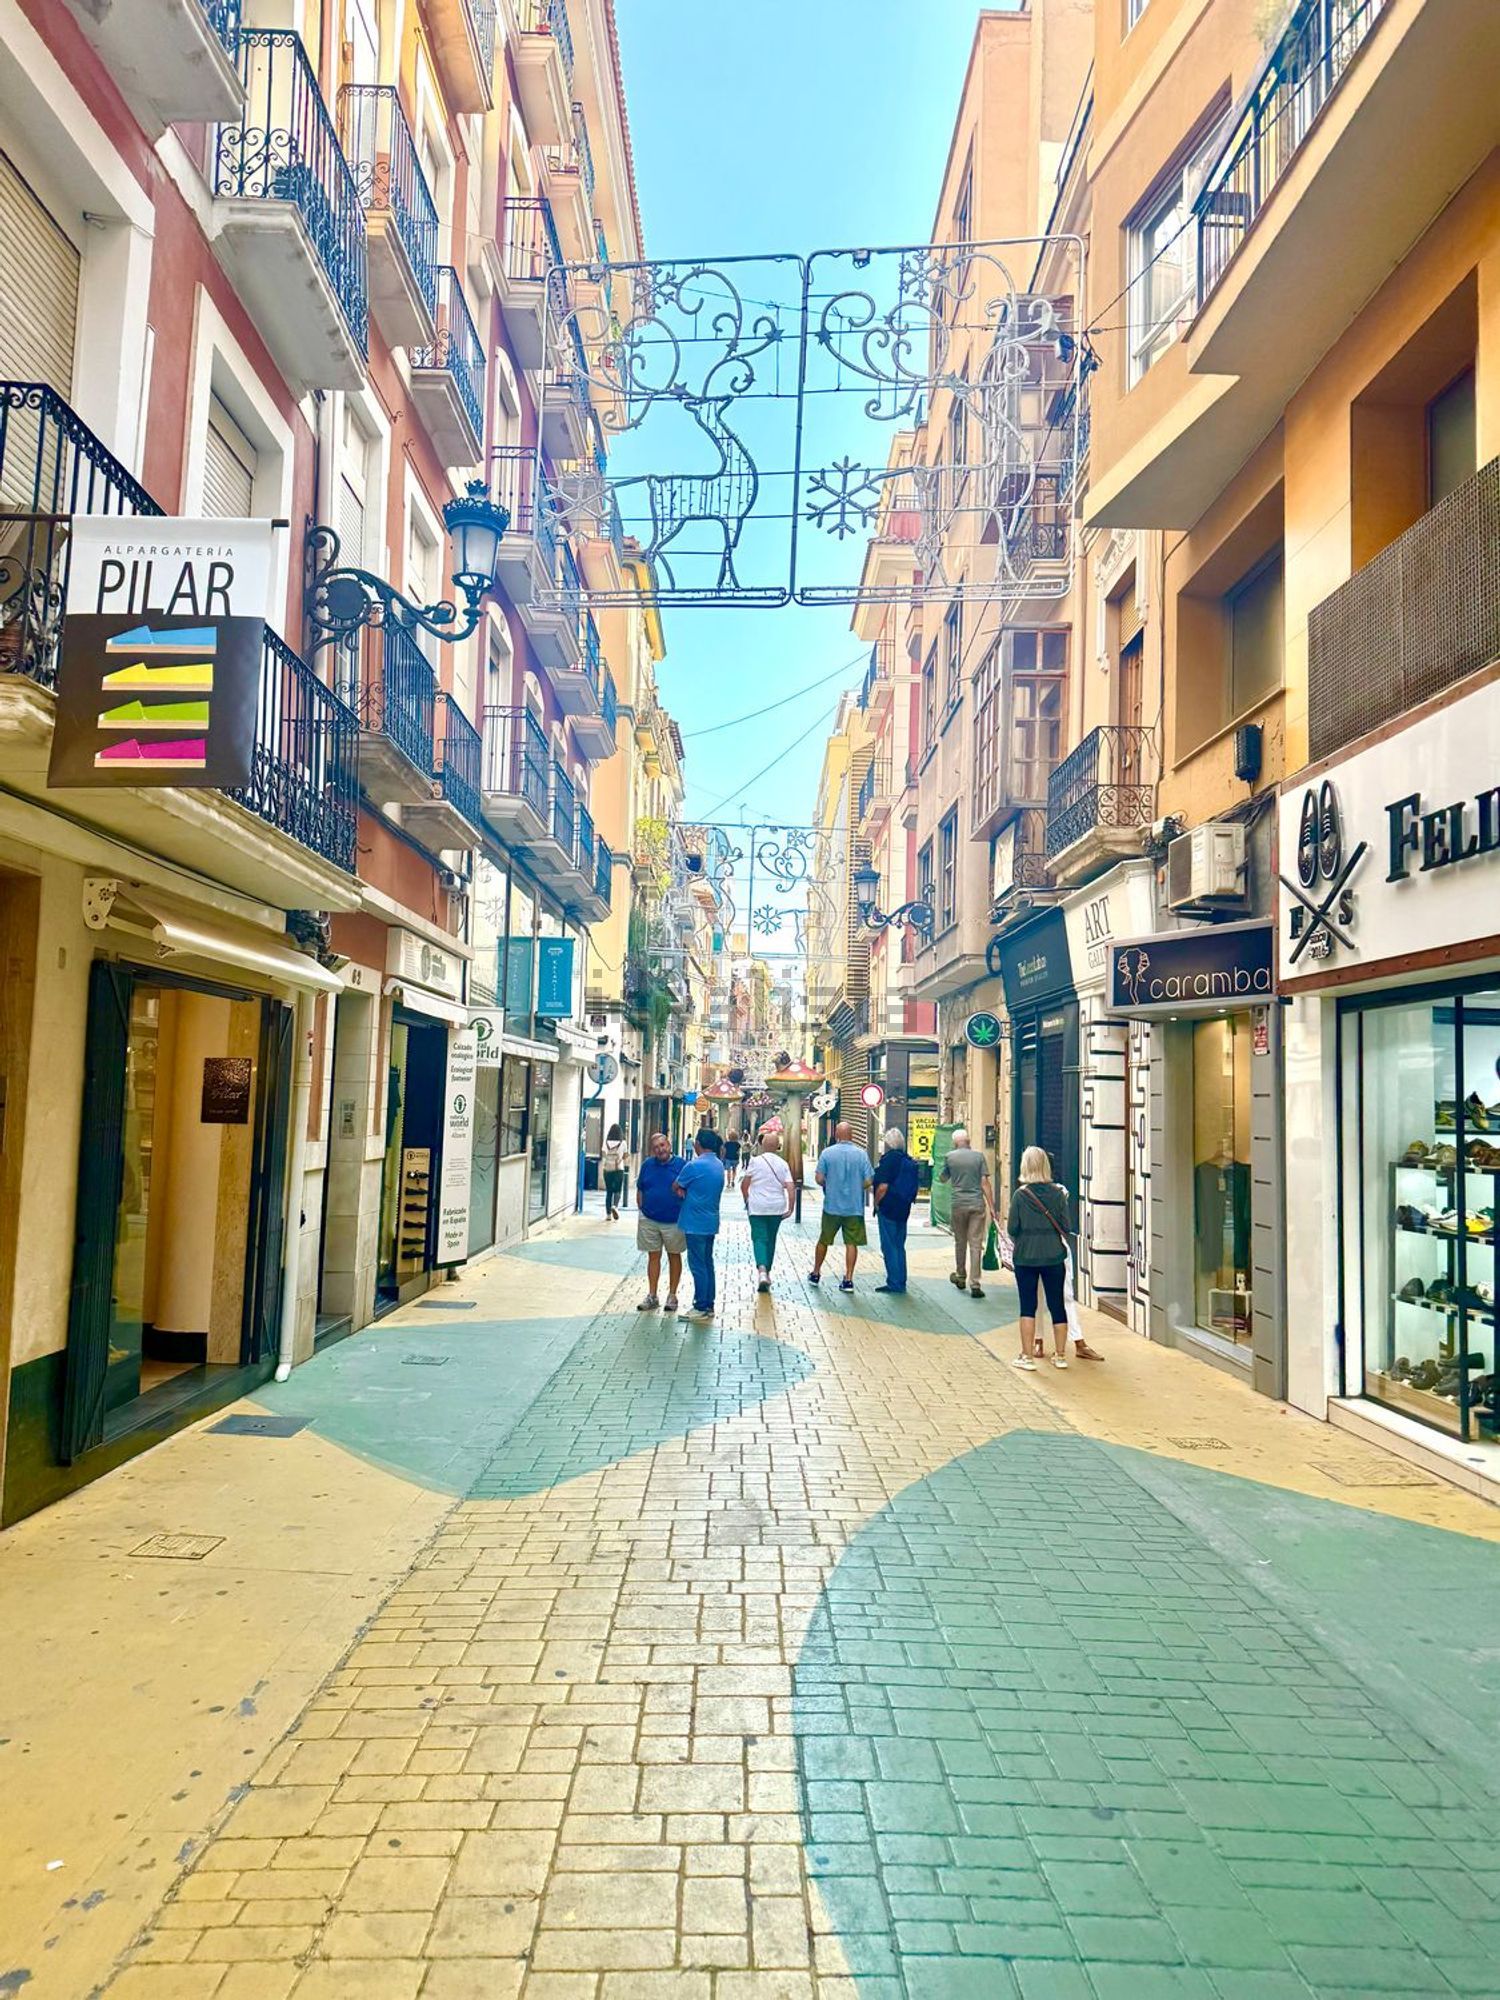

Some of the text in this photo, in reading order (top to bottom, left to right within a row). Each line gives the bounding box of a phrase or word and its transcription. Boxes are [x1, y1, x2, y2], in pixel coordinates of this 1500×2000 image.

[104, 545, 234, 556] ALPARGATERÍA
[96, 559, 235, 616] PILAR
[1085, 895, 1111, 944] ART
[1289, 889, 1354, 940] F S
[1088, 946, 1105, 969] GALL
[1150, 966, 1271, 999] caramba
